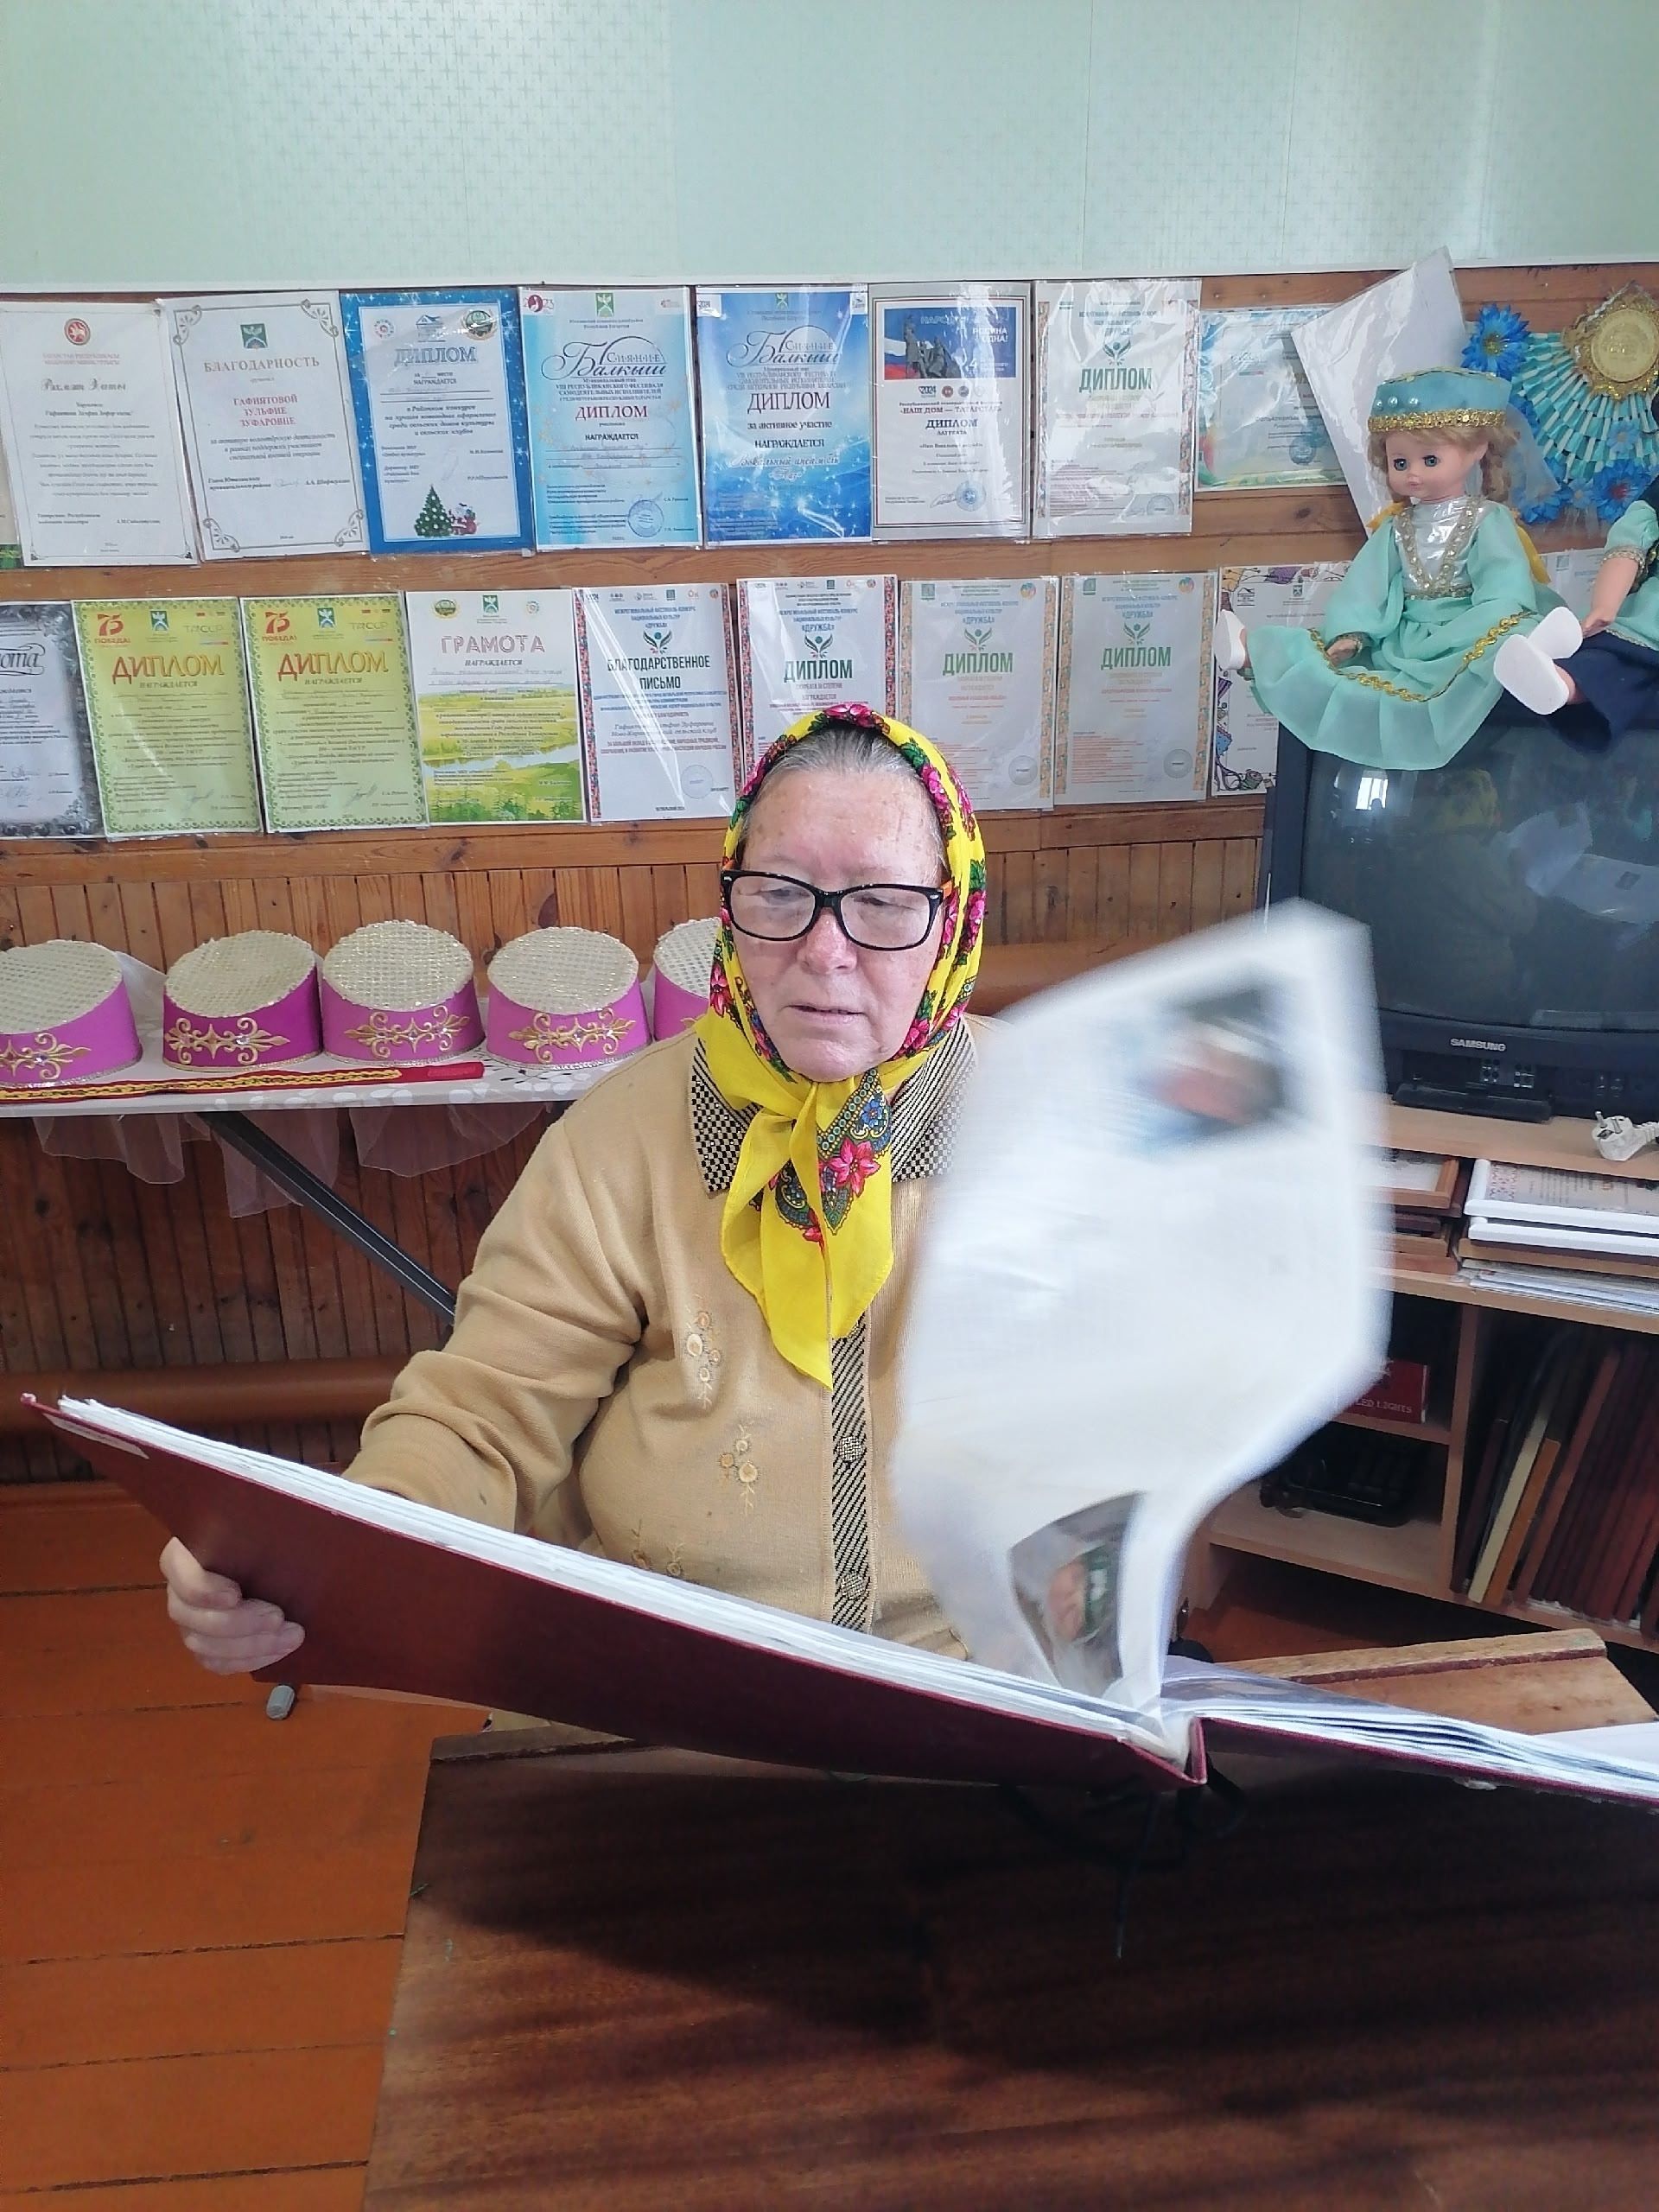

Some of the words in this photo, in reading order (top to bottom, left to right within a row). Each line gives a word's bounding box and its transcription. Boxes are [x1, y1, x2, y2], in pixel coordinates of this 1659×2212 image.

[203, 356, 320, 372] БЛАГОДАРНОСТЬ
[394, 346, 477, 366] ДИПЛОМ
[1079, 367, 1153, 392] ДИПЛОМ
[747, 392, 830, 414] ДИПЛОМ
[575, 405, 647, 421] ДИПЛОМ
[799, 421, 832, 430] участие
[925, 419, 978, 429] ДИПЛОМ
[585, 433, 639, 442] НАГРАЖДАЕТСЯ
[754, 439, 824, 448] НАГРАЖДАЕТСЯ
[97, 613, 124, 636] 75
[264, 612, 289, 634] 75
[802, 624, 835, 632] «ДРУЖБА»
[441, 634, 545, 653] ГРАМОТА
[278, 651, 389, 682] ДИПЛОМ
[607, 655, 710, 671] БЛАГОДАРСТВЕННОЕ
[943, 652, 1013, 676] ДИПЛОМ
[1101, 647, 1171, 671] ДИПЛОМ
[112, 654, 225, 684] ДИПЛОМ
[784, 659, 853, 683] ДИПЛОМ
[639, 676, 681, 690] ПИСЬМО
[1451, 1038, 1506, 1052] SAMSUNG
[1376, 1401, 1412, 1414] LIGHTS
